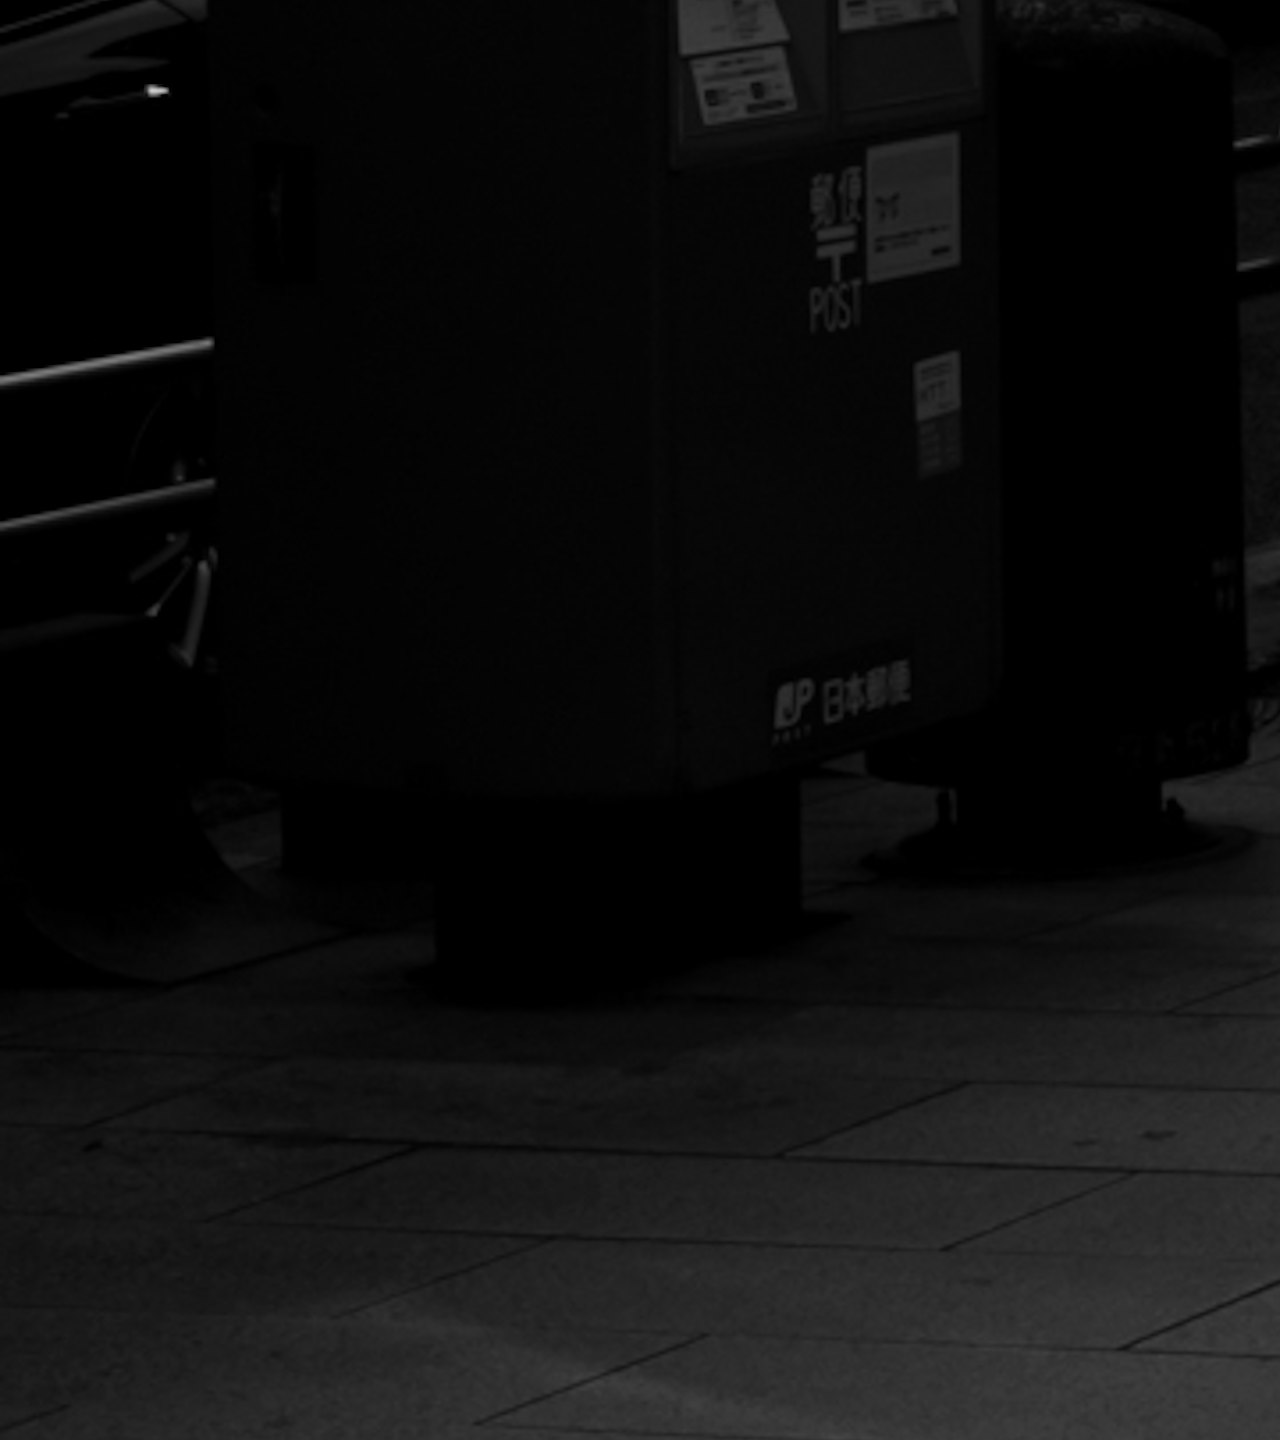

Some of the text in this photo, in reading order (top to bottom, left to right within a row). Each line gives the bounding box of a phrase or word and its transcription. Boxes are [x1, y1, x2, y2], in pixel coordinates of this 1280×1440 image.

[809, 167, 862, 232] 郵便
[809, 279, 862, 334] POST
[773, 657, 912, 731] JP 日本郵便
